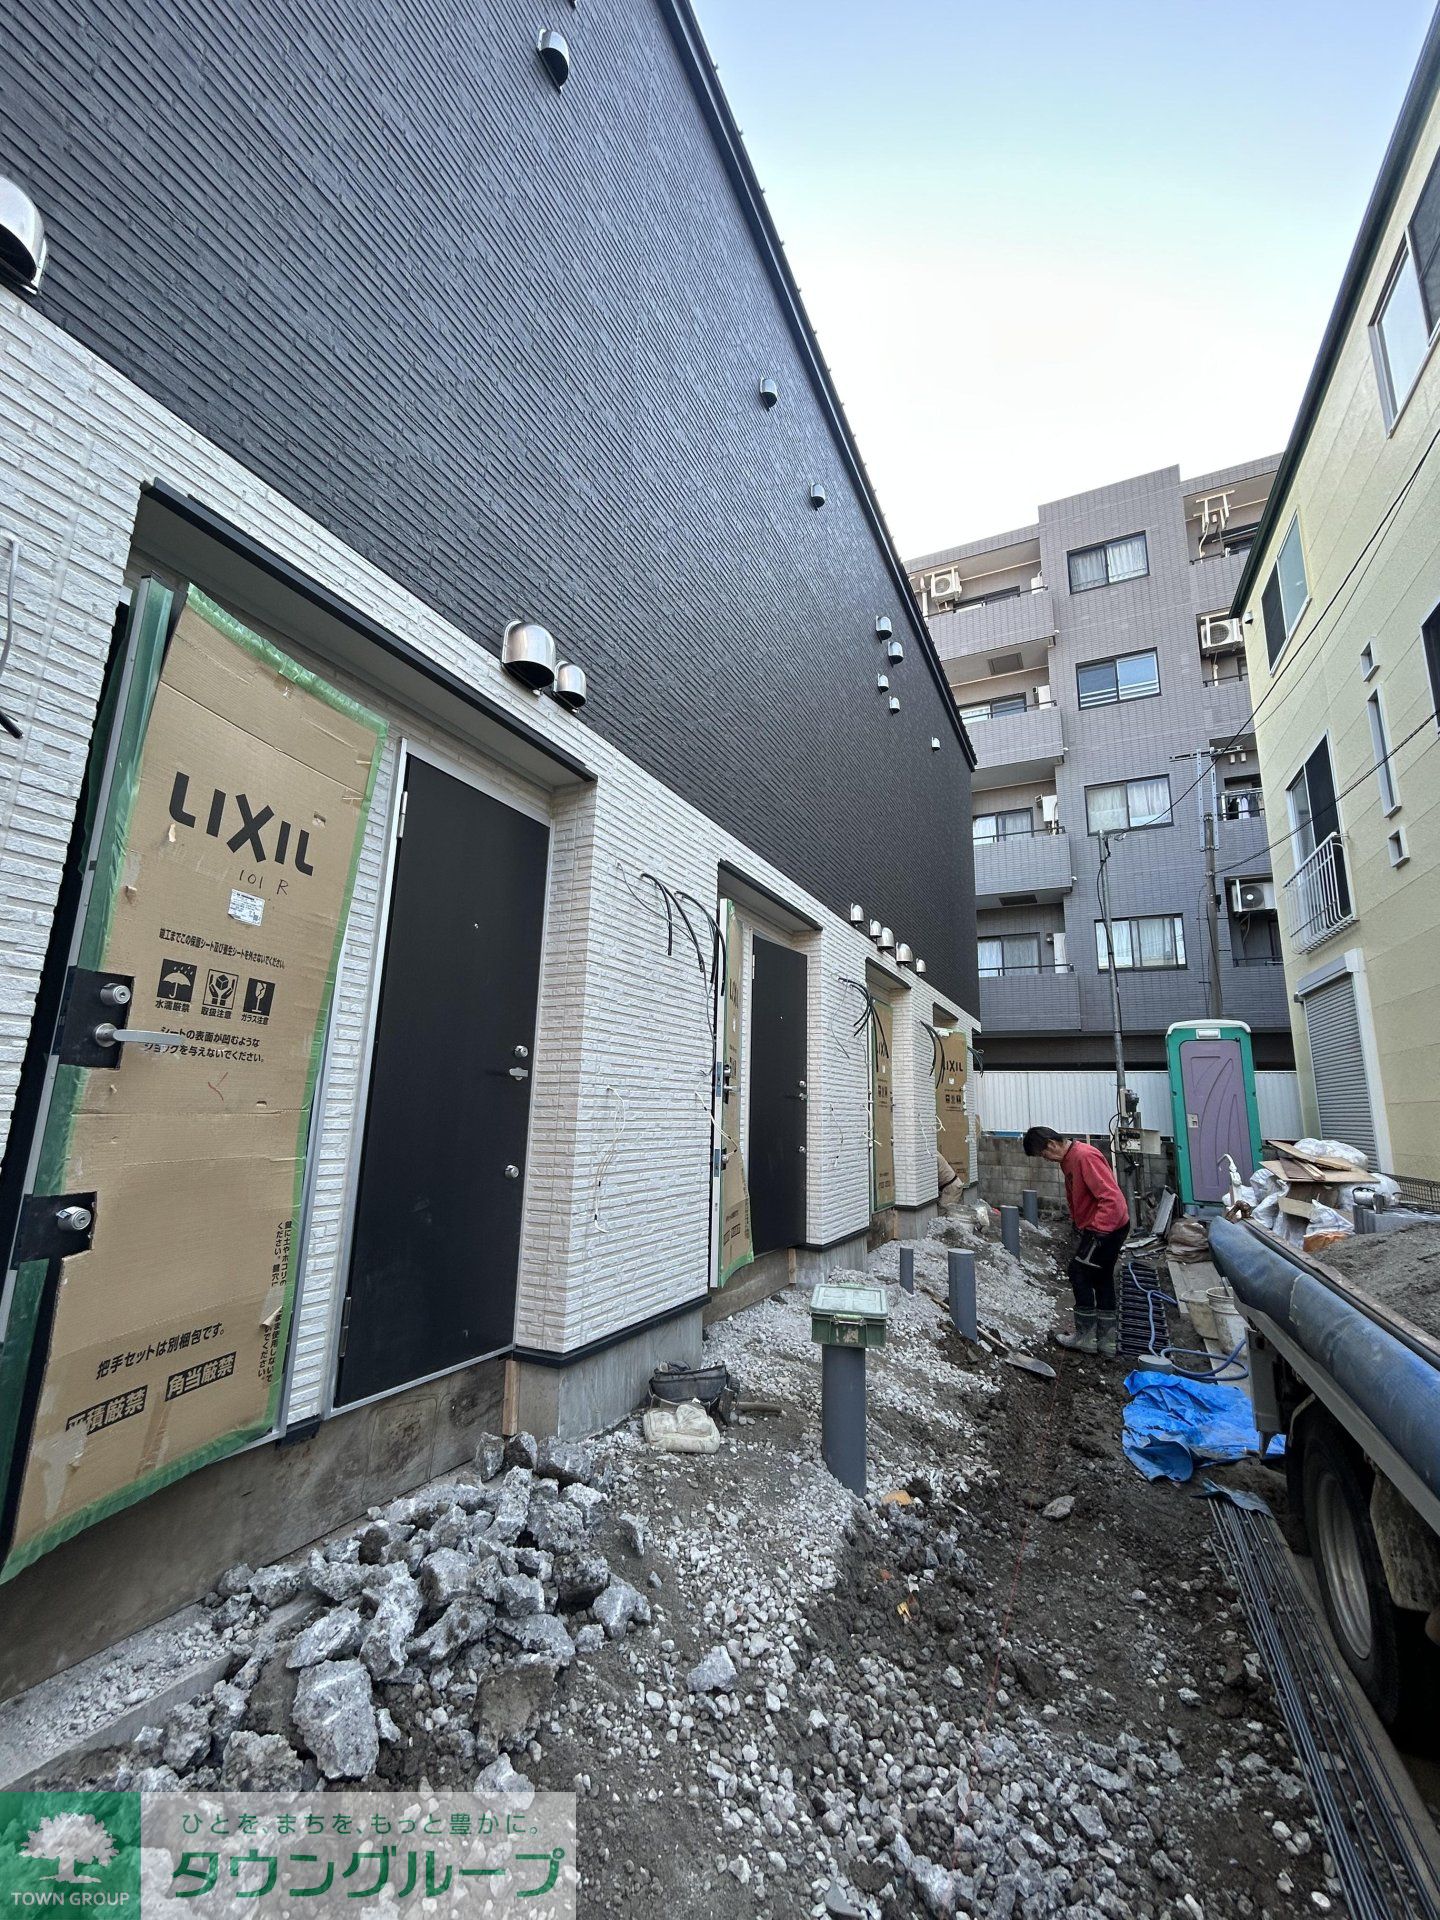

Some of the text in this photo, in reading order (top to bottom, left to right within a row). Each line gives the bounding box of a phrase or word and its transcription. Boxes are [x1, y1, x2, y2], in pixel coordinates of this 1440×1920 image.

[168, 771, 314, 877] LIXIL
[239, 869, 289, 896] 101 R
[154, 999, 191, 1014] 水濡厳禁
[200, 1006, 232, 1020] 取扱注意
[240, 1013, 270, 1026] ガラス注意
[160, 1026, 261, 1048] シートの表面が凹むような
[944, 1060, 964, 1073] IXIL
[96, 1322, 225, 1380] 把手セットは別梱包です。
[166, 1354, 236, 1400] 角当厳禁
